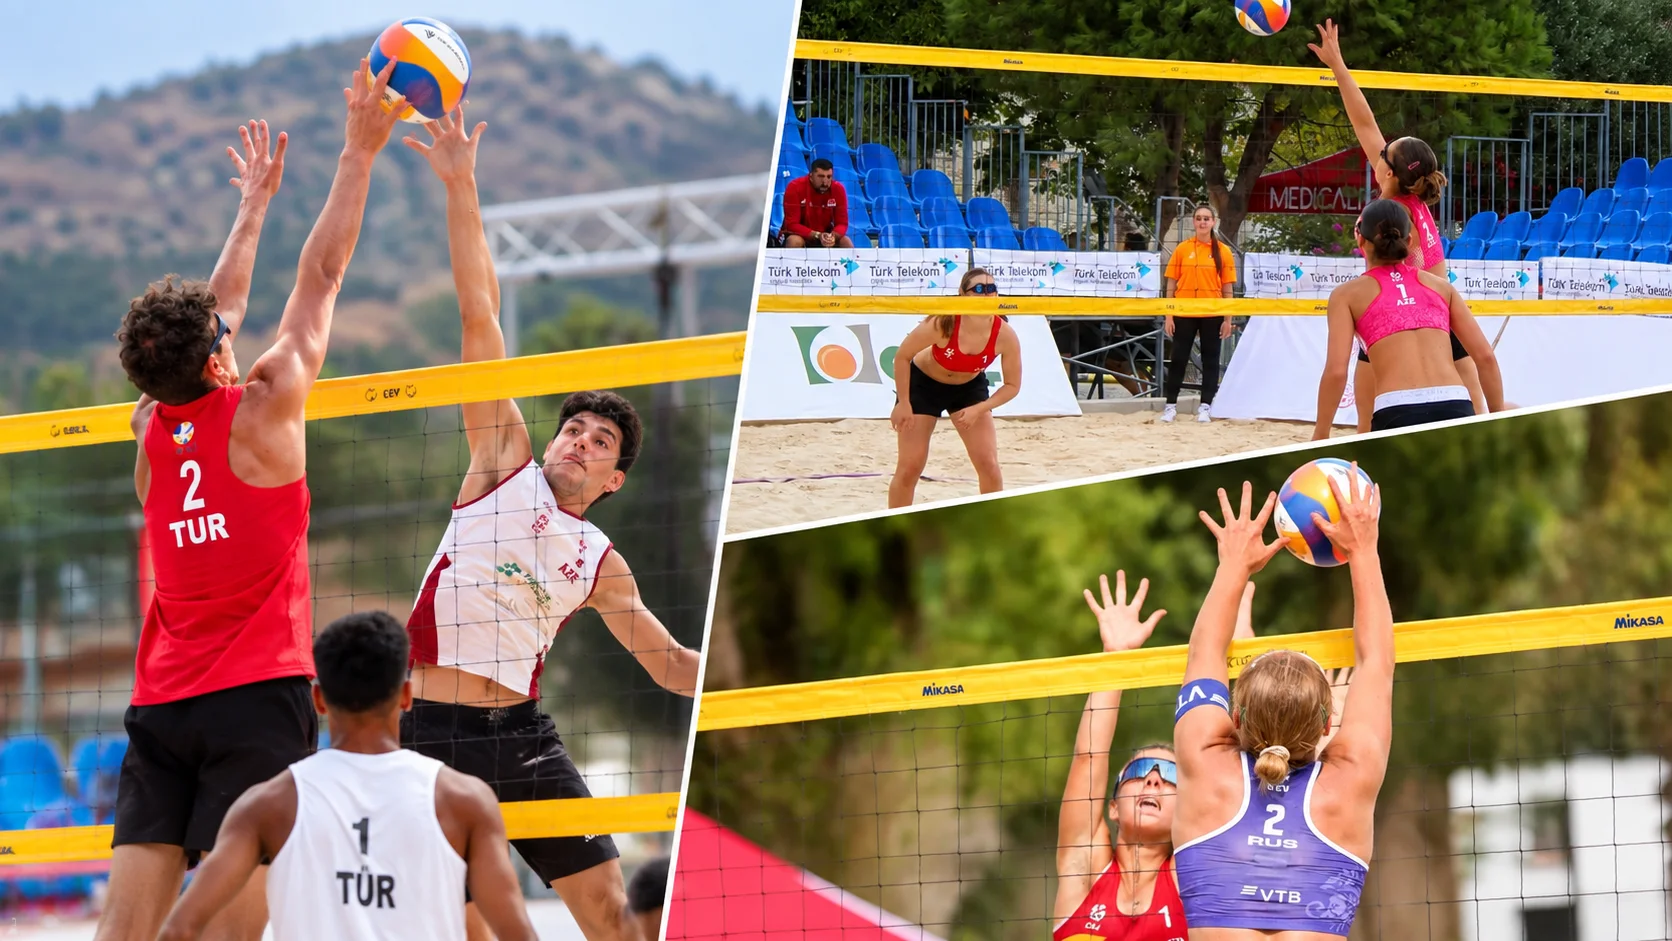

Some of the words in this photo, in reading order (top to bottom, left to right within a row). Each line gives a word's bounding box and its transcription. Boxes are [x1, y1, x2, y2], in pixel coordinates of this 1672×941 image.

[768, 266, 792, 277] Türk
[795, 265, 841, 278] Telekom
[869, 266, 893, 277] Türk
[897, 265, 940, 277] Telekom
[1075, 269, 1095, 278] Türk
[1098, 269, 1136, 279] Telekom
[1396, 283, 1408, 299] 1
[180, 459, 206, 512] 2
[168, 512, 230, 548] TUR
[1262, 803, 1286, 836] 2
[352, 817, 370, 856] 1
[1247, 834, 1299, 849] RUS
[1260, 888, 1302, 905] VTB
[1158, 904, 1173, 929] 1
